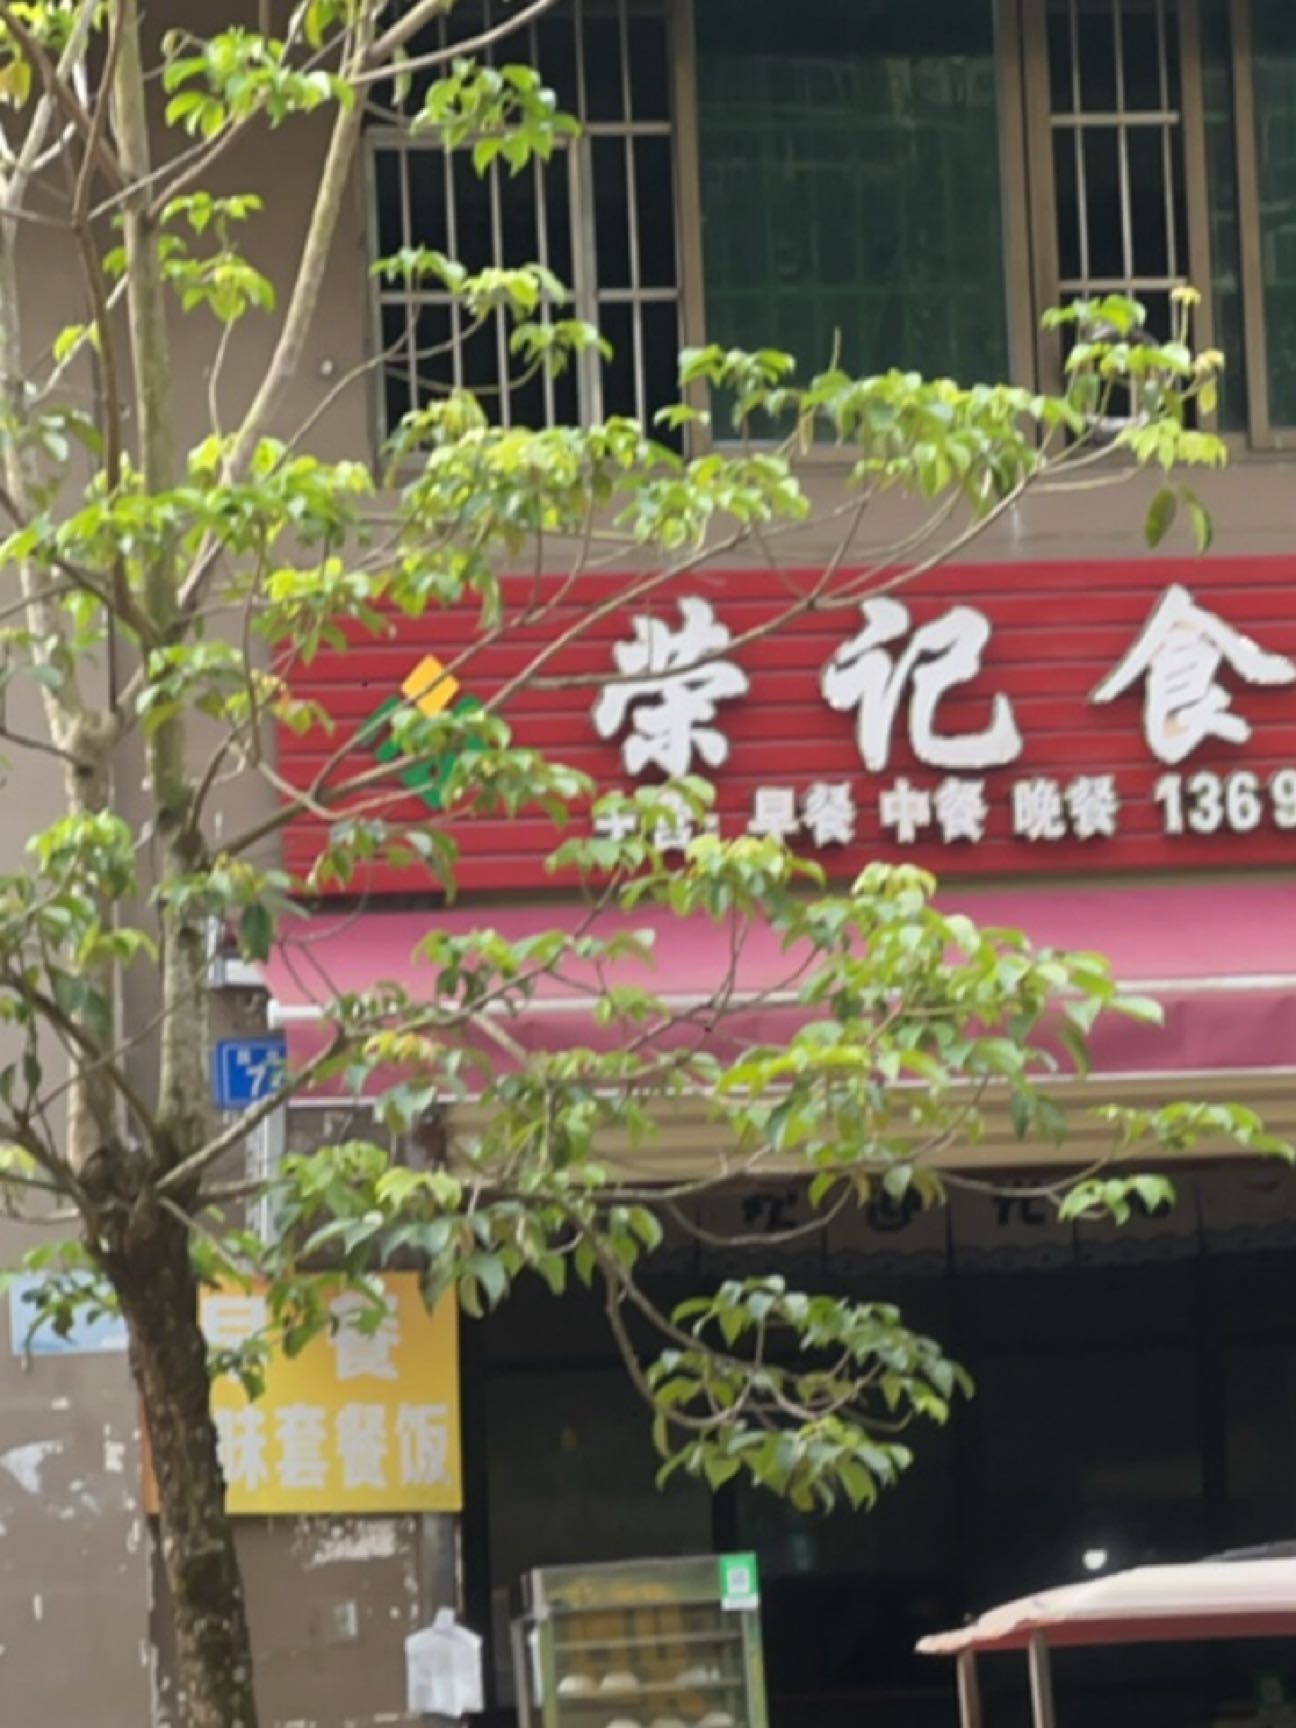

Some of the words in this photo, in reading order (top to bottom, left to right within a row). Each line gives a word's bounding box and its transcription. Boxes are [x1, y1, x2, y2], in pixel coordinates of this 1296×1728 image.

[747, 779, 856, 848] 早餐
[879, 776, 989, 845] 中餐
[1012, 774, 1118, 842] 晚餐
